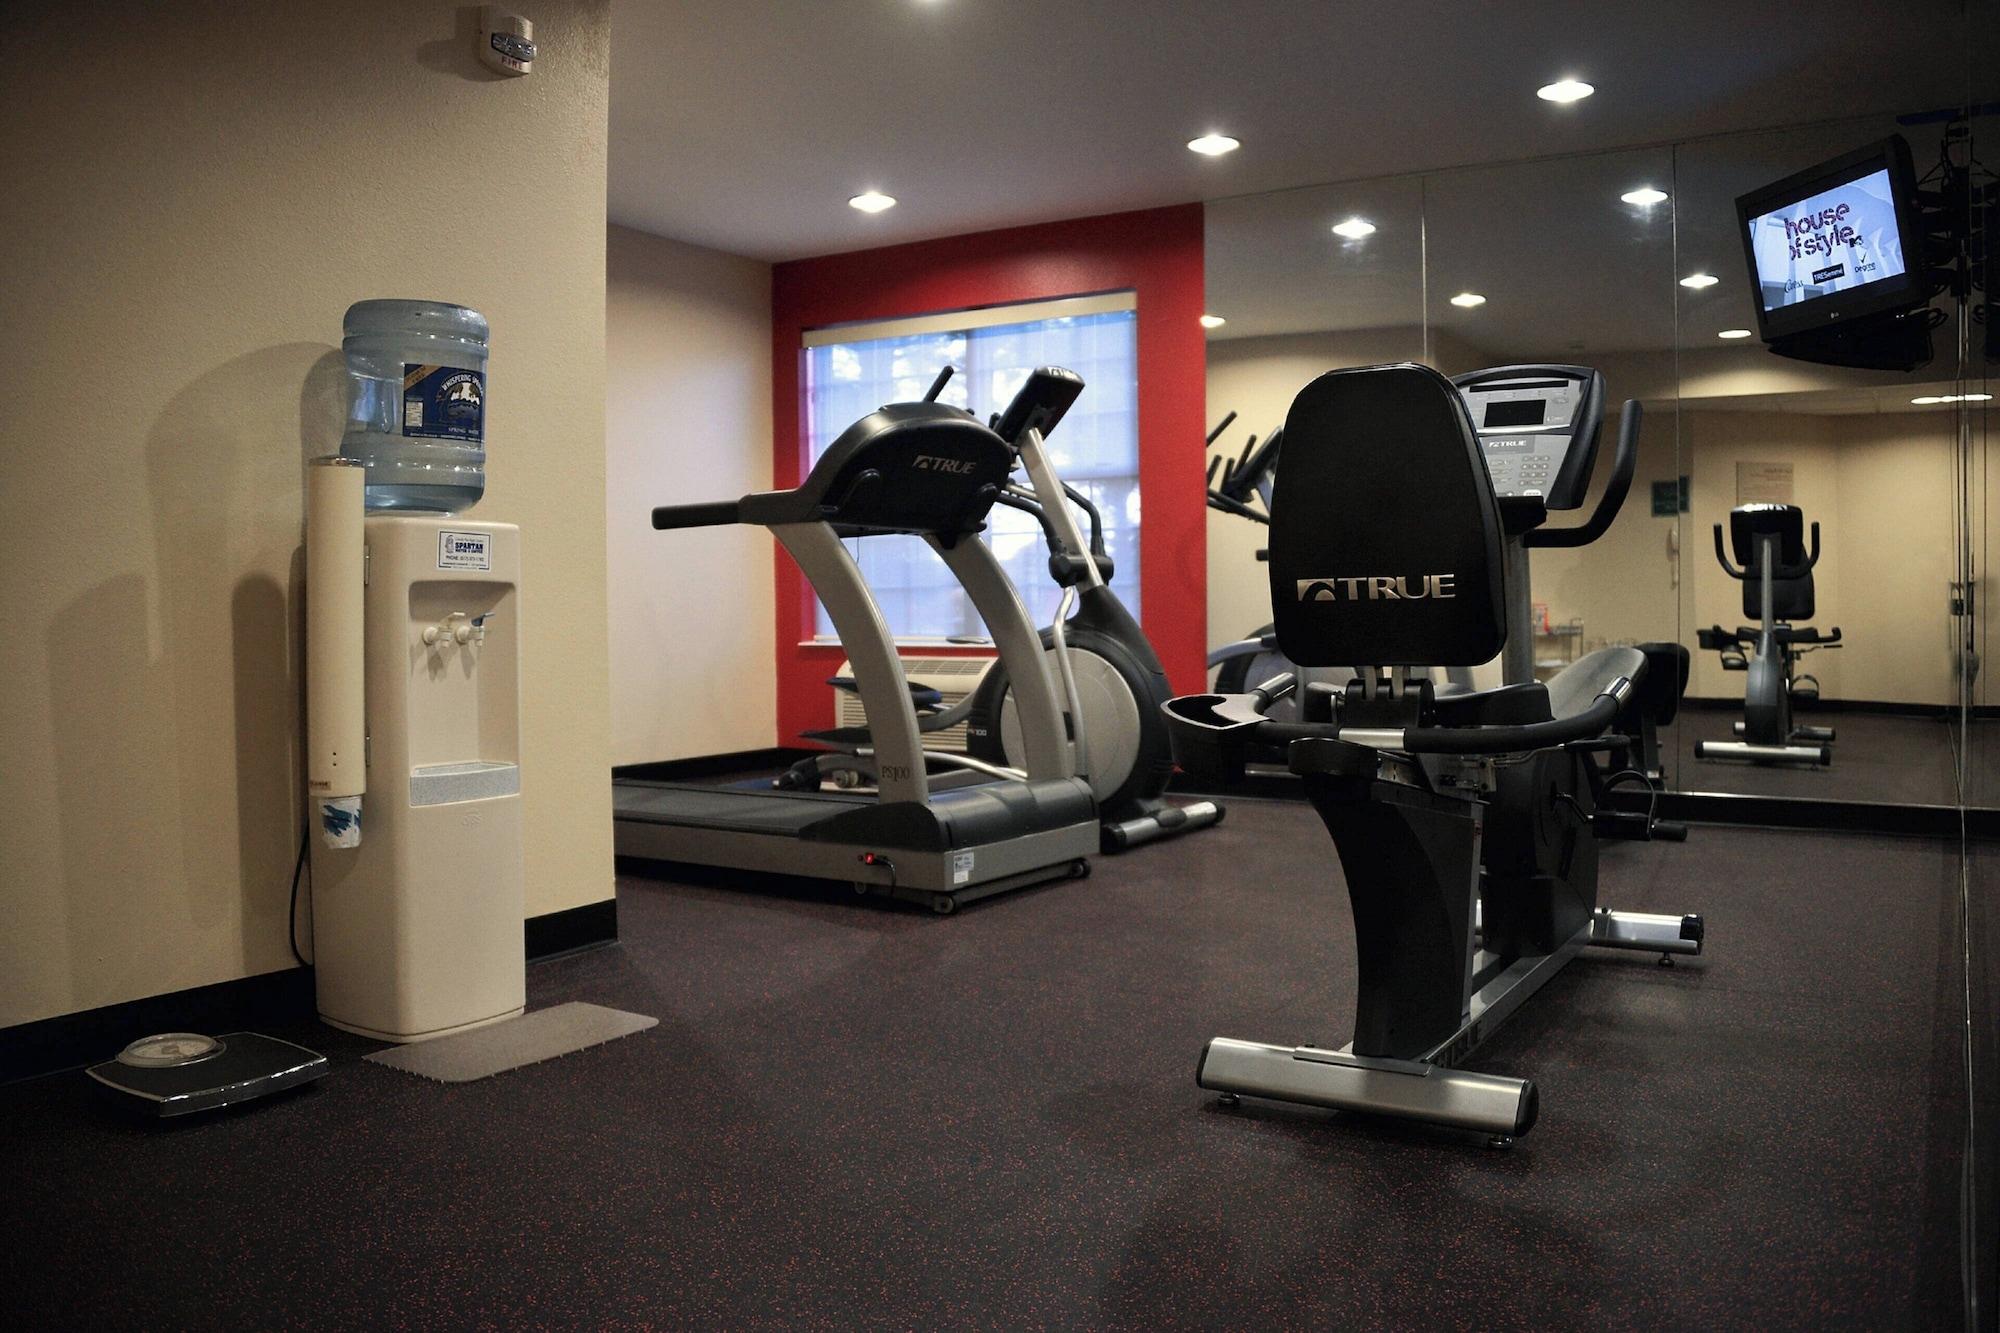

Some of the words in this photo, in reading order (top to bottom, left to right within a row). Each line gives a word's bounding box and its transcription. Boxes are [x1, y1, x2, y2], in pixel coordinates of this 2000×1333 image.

[502, 57, 522, 70] FIRE
[1784, 203, 1850, 239] house
[1805, 223, 1855, 257] style
[1500, 439, 1527, 448] TRUE
[933, 457, 976, 474] TRUE
[1337, 573, 1456, 600] TRUE
[882, 767, 911, 782] PS100
